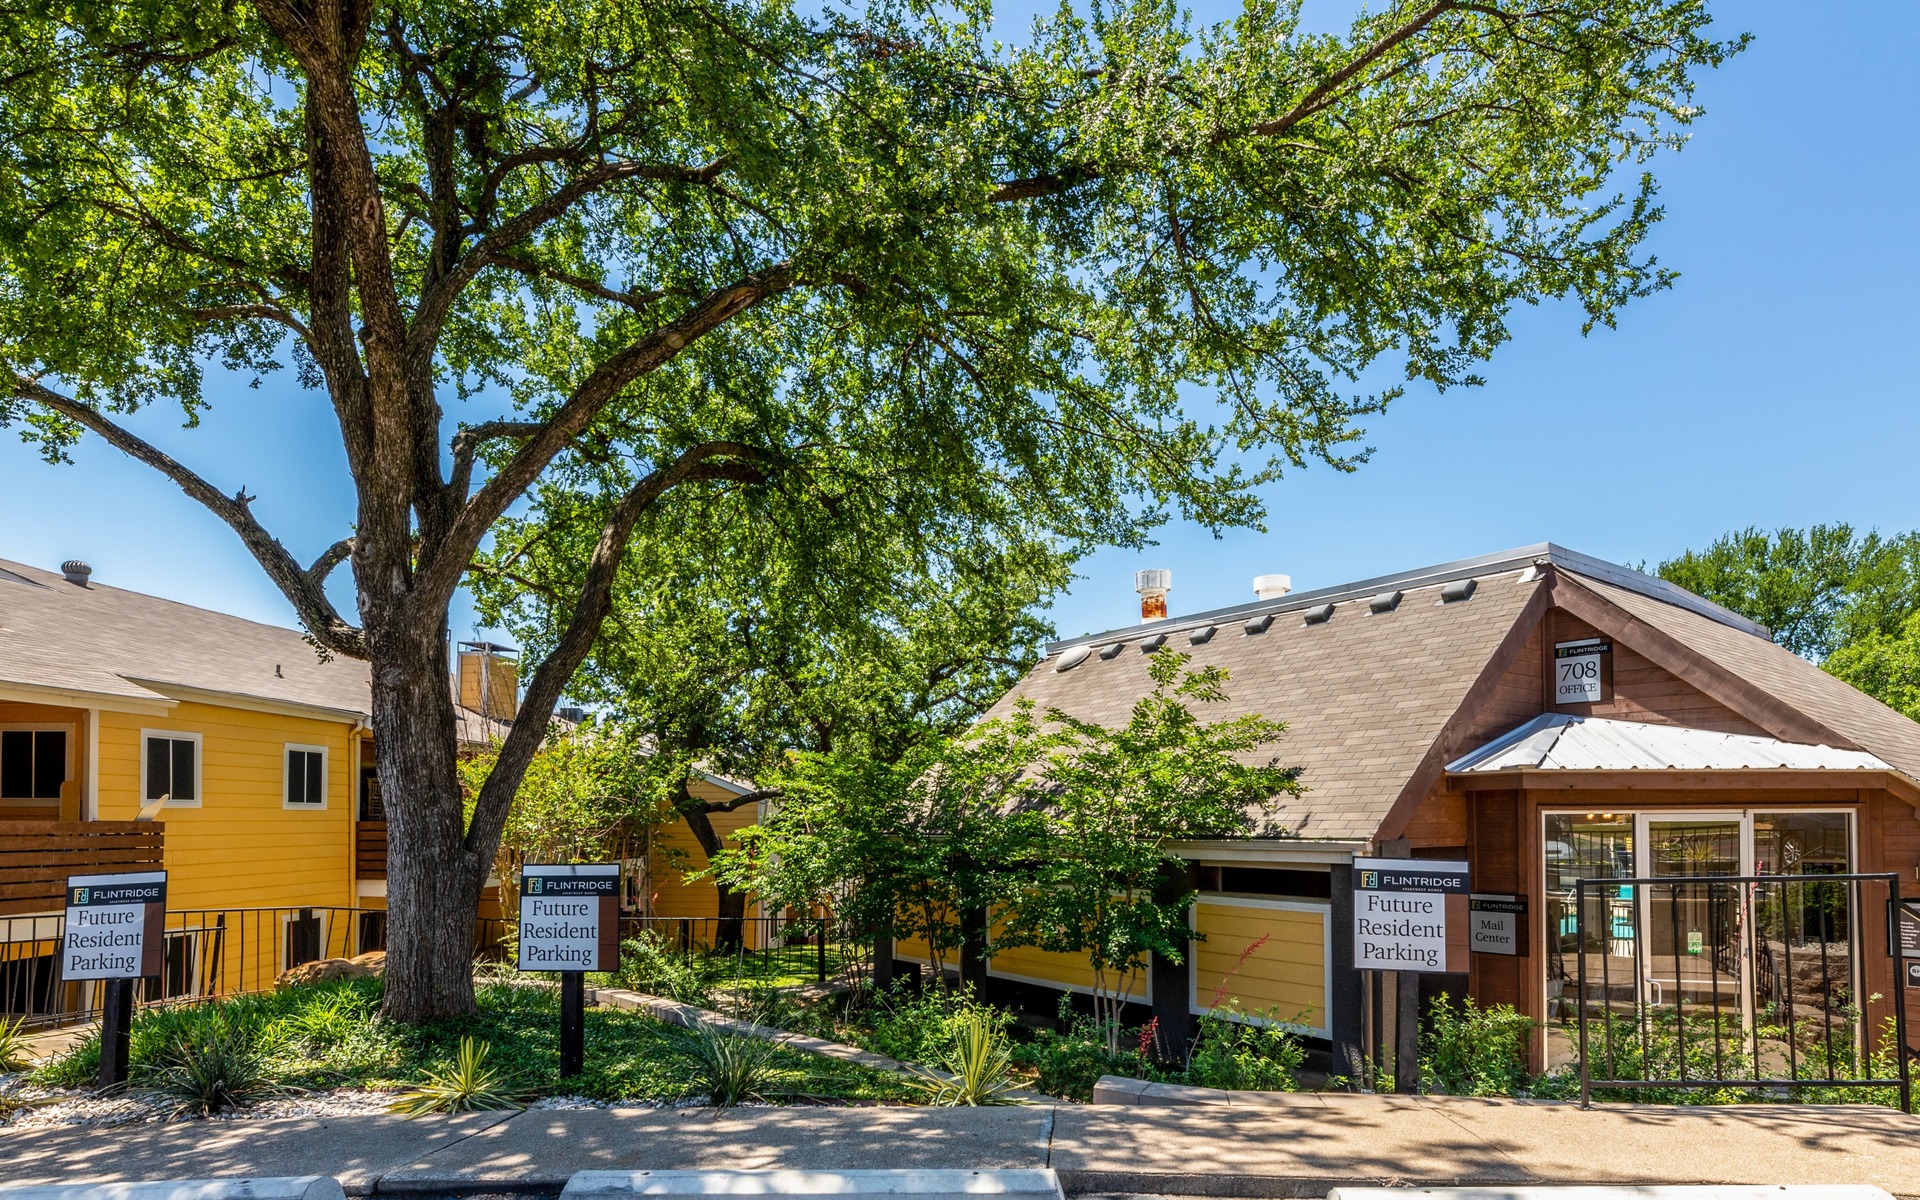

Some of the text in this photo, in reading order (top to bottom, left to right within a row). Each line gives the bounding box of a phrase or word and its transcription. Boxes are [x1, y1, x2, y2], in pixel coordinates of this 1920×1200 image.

[1570, 645, 1608, 654] FLINTRIDGE
[1560, 661, 1597, 681] 708
[1559, 683, 1597, 694] OFFICE
[547, 881, 613, 890] FLINTRIDGE
[1383, 876, 1461, 887] FLINTRIDGE
[93, 888, 159, 899] FLINTRIDGE
[532, 900, 589, 916] Future
[1367, 894, 1433, 914] Future
[77, 910, 134, 926] Future
[1481, 920, 1504, 930] Mail
[523, 922, 597, 938] Resident
[1358, 918, 1444, 938] Resident
[67, 930, 142, 948] Resident
[1475, 931, 1510, 944] Center
[527, 944, 592, 966] Parking
[1363, 942, 1438, 967] Parking
[70, 953, 136, 973] Parking
